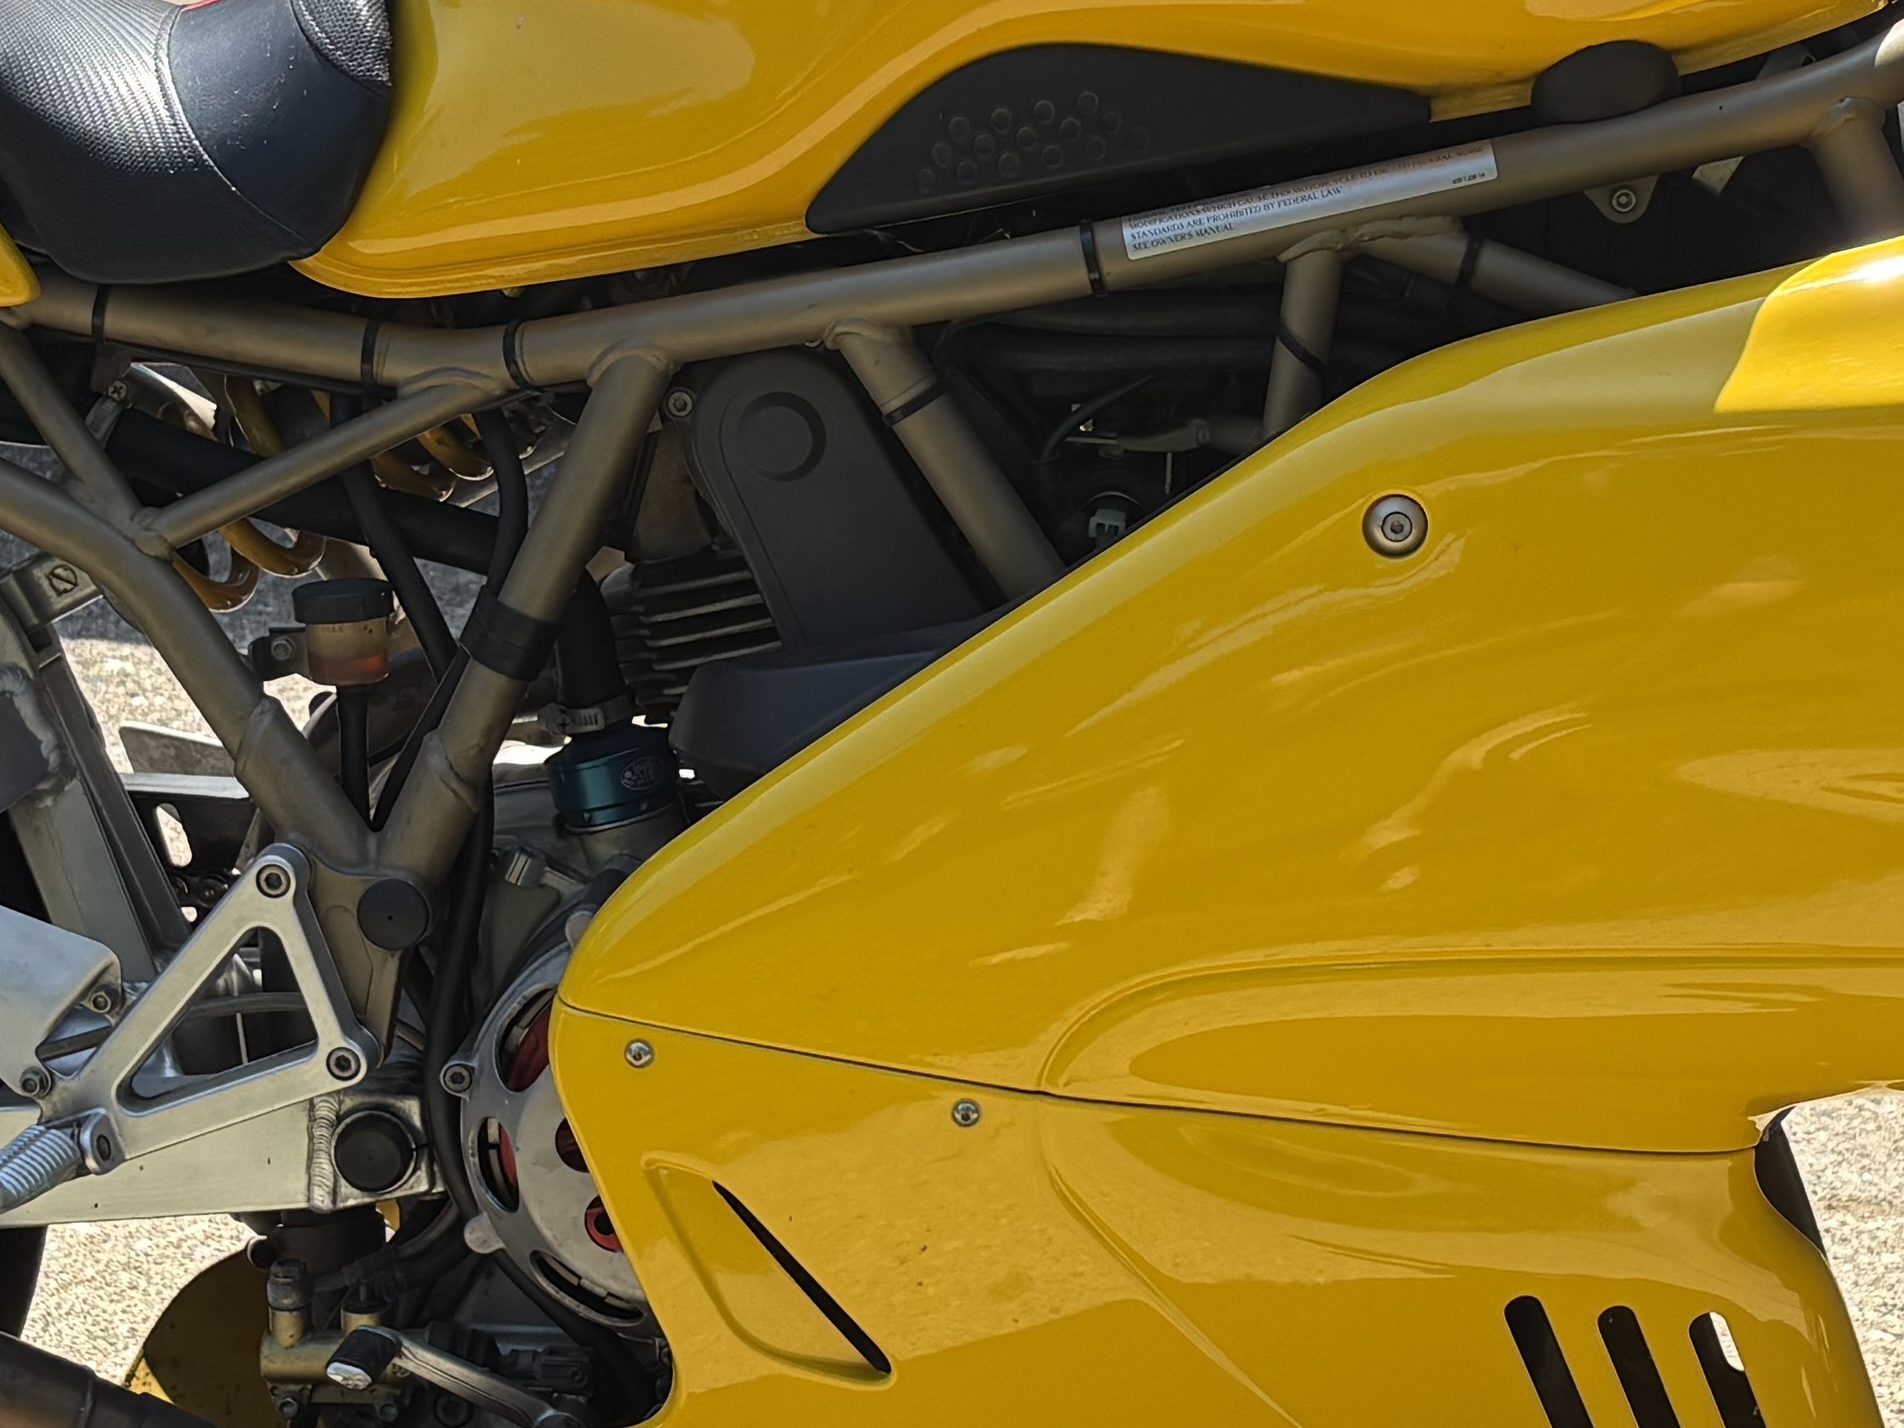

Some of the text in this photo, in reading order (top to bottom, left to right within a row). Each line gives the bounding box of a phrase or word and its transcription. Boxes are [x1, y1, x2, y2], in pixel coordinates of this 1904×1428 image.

[1130, 222, 1184, 241] STANDARDS
[1185, 217, 1206, 228] ARE
[1206, 204, 1261, 224] PROHIBITED
[1263, 201, 1277, 211] BY
[1276, 191, 1319, 208] FEDERAL
[1133, 240, 1150, 251] SEE
